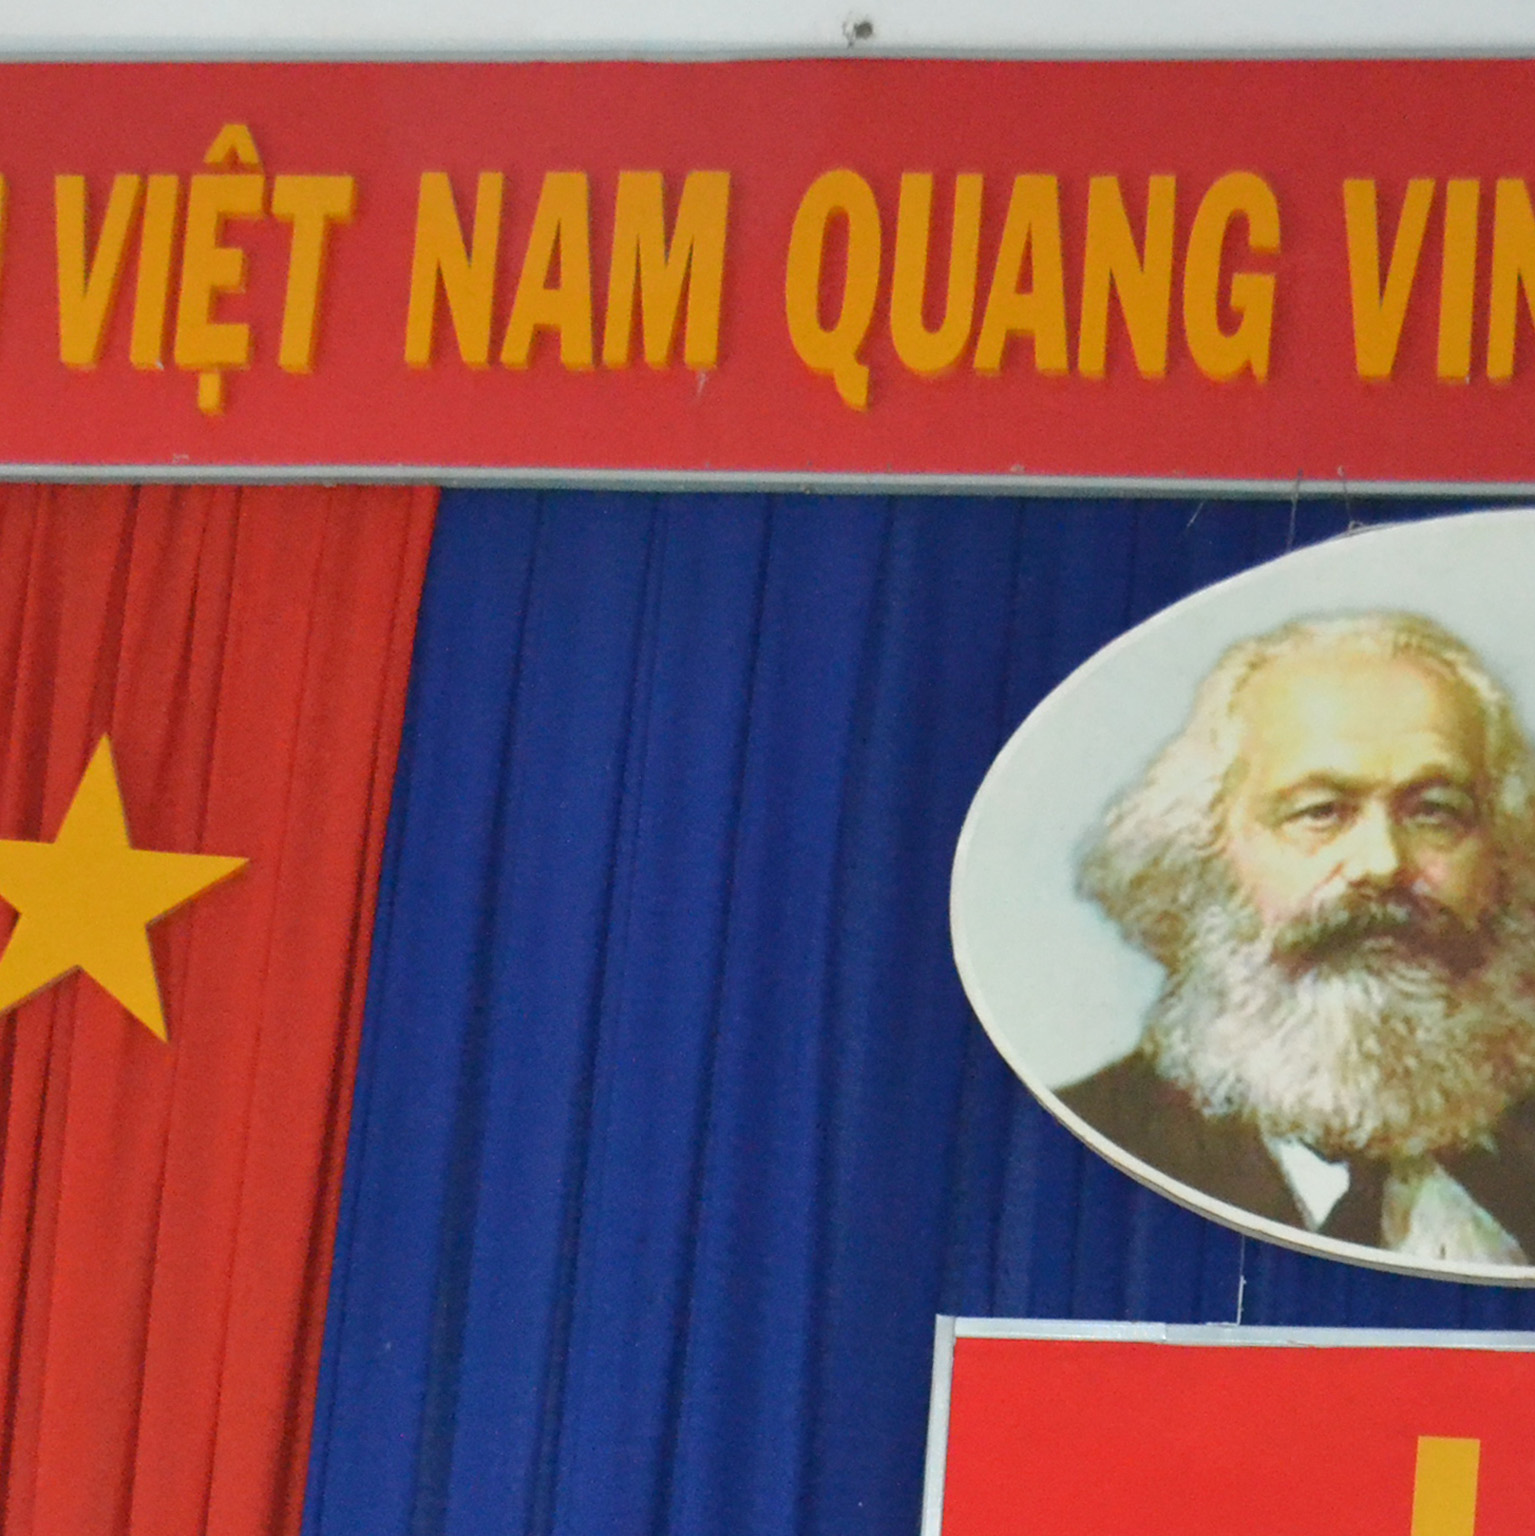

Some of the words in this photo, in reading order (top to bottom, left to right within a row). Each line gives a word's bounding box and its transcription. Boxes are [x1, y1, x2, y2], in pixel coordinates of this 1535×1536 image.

[53, 123, 359, 417] VIỆT
[403, 168, 732, 373] NAM
[785, 168, 1281, 413] QUANG
